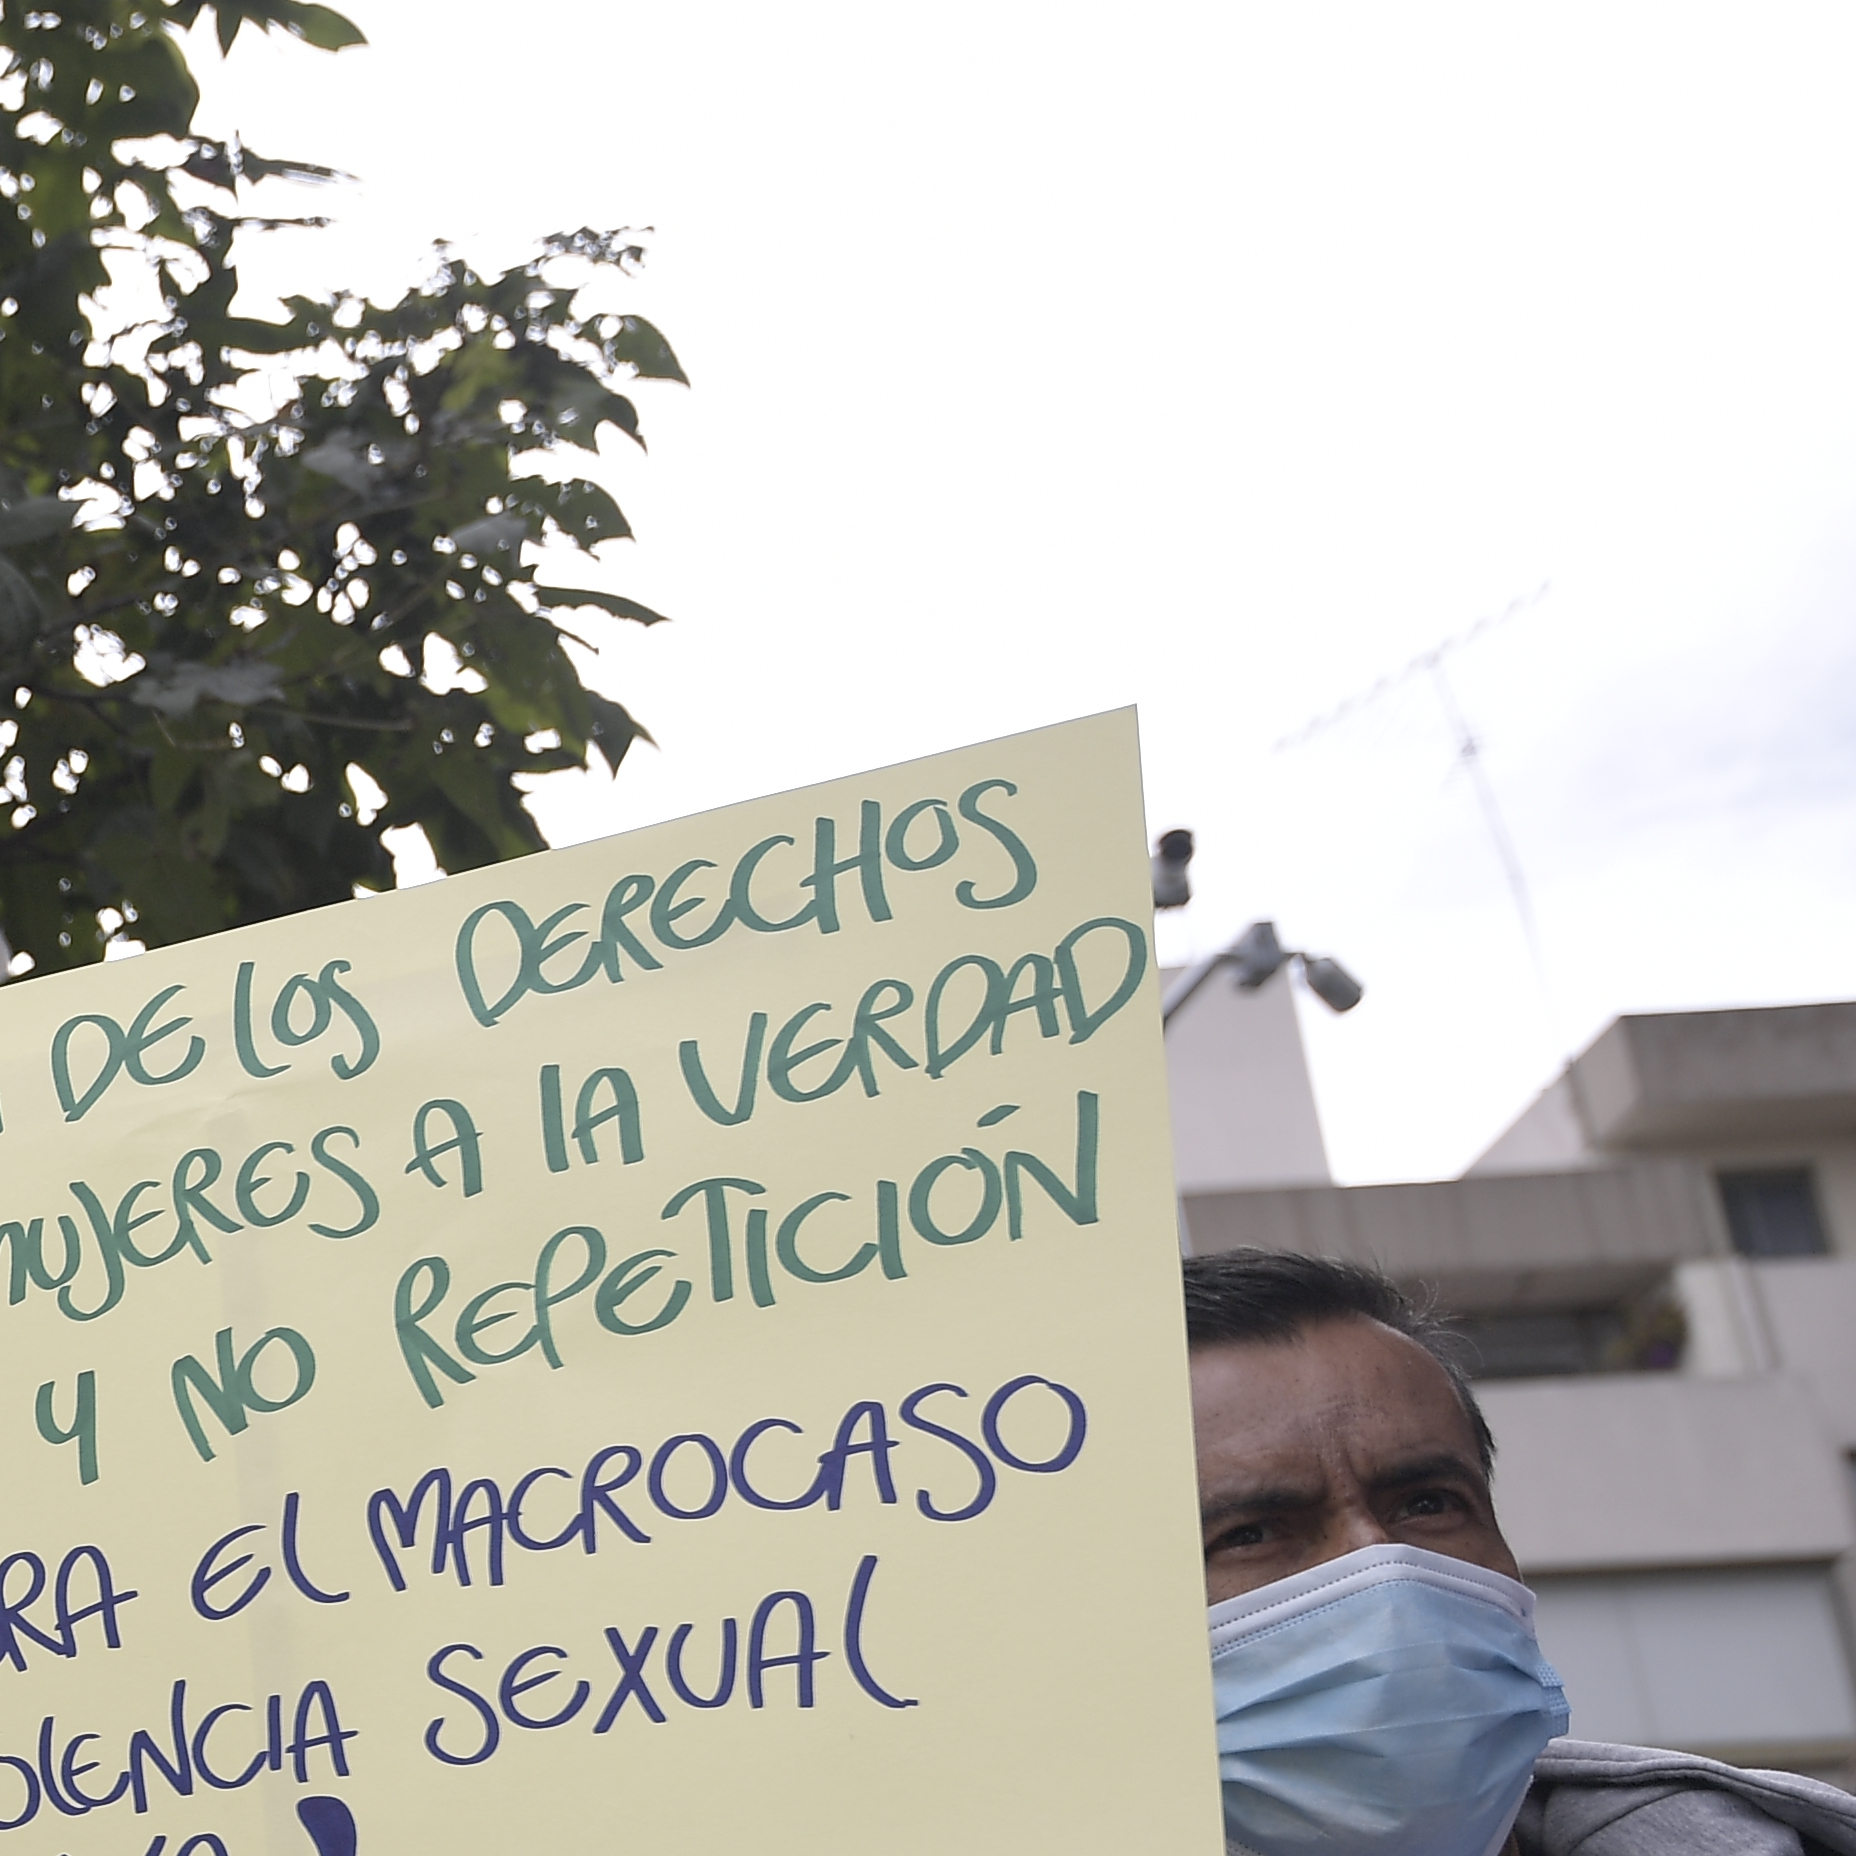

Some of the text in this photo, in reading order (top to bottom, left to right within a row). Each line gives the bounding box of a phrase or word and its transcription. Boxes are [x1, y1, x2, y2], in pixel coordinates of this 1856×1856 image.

[51, 985, 205, 1123] DE
[456, 778, 1039, 1027] DERECHOS
[405, 1097, 484, 1198] A
[679, 917, 1149, 1128] VERDAD
[170, 1325, 315, 1464] NO
[370, 1374, 1088, 1596] MACROCASO
